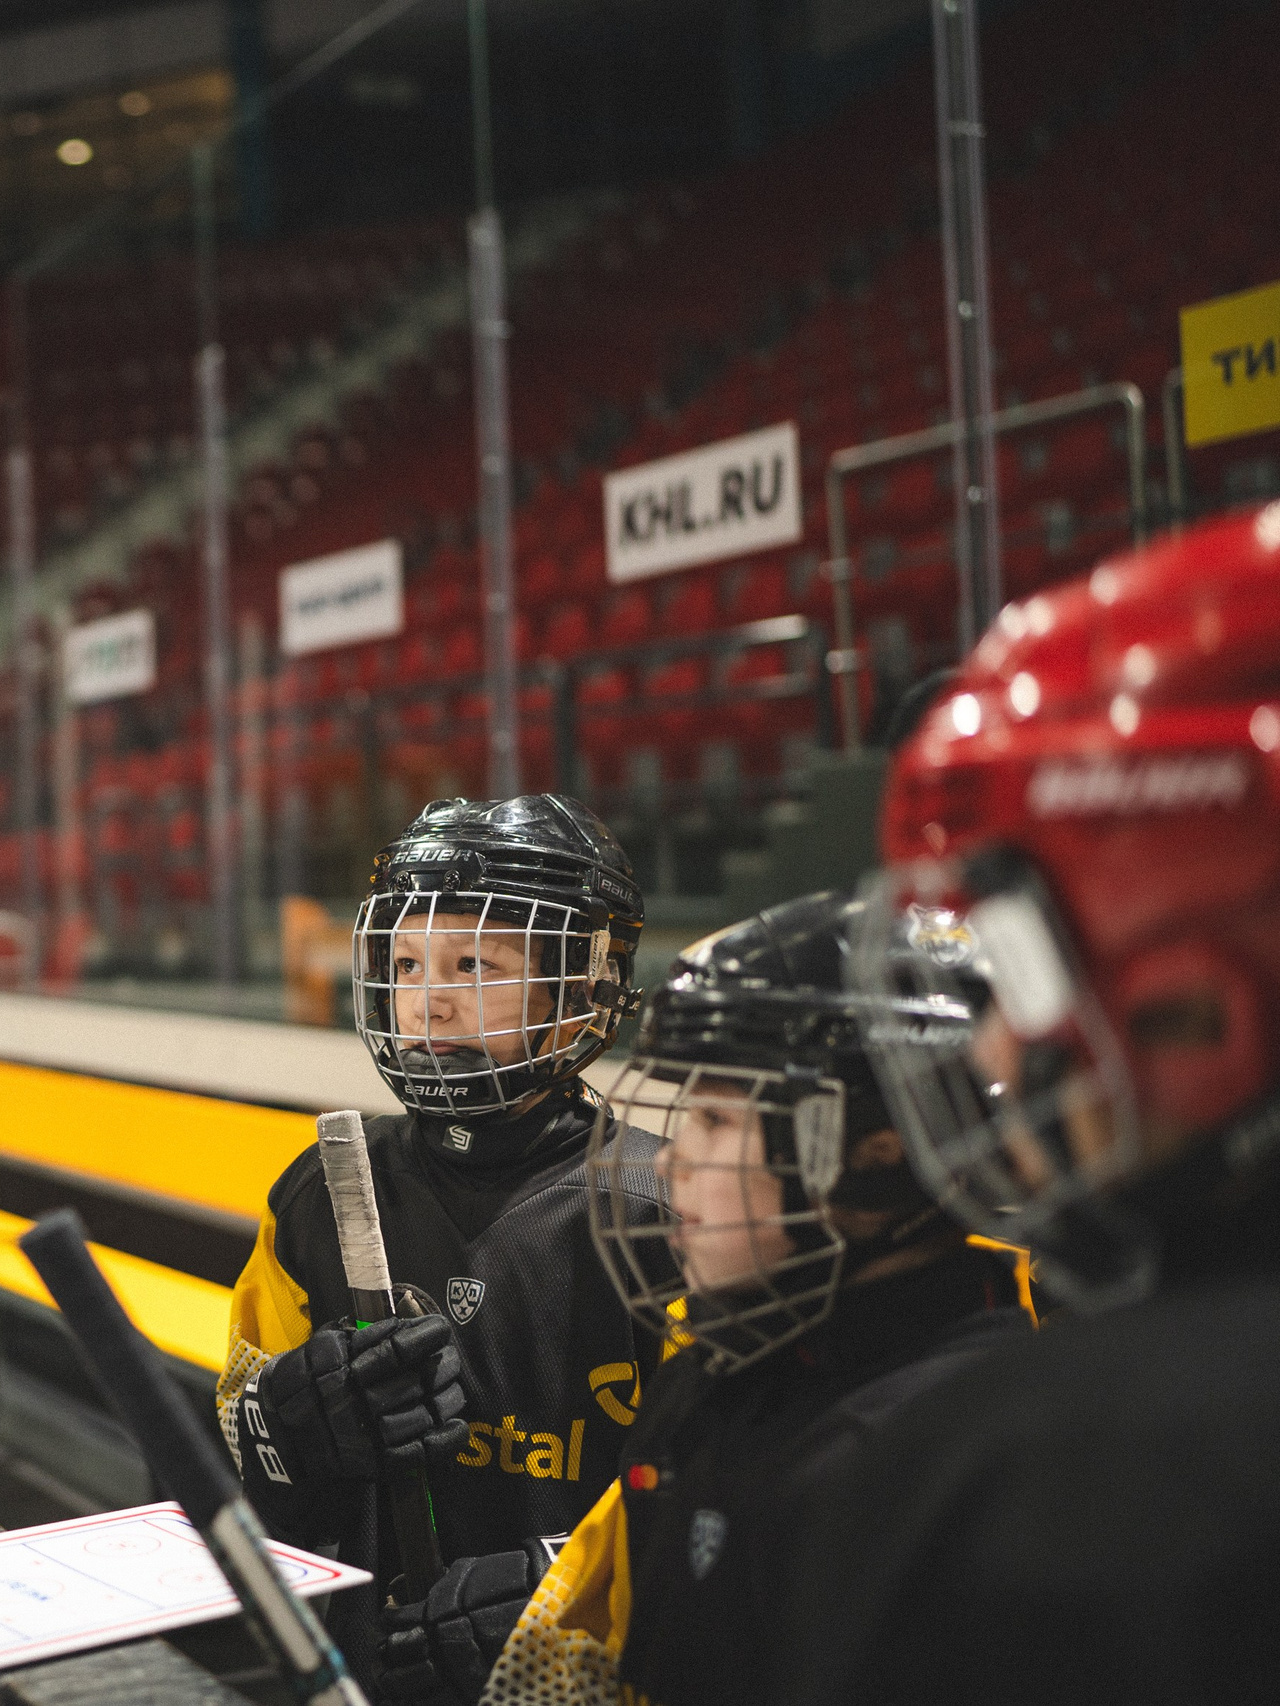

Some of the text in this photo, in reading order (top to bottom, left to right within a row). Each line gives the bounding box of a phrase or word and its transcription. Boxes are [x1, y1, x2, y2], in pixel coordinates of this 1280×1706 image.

[621, 456, 784, 543] KHL.RU
[392, 849, 473, 865] BAUER
[404, 1084, 469, 1097] BAUER
[456, 1415, 585, 1481] stal
